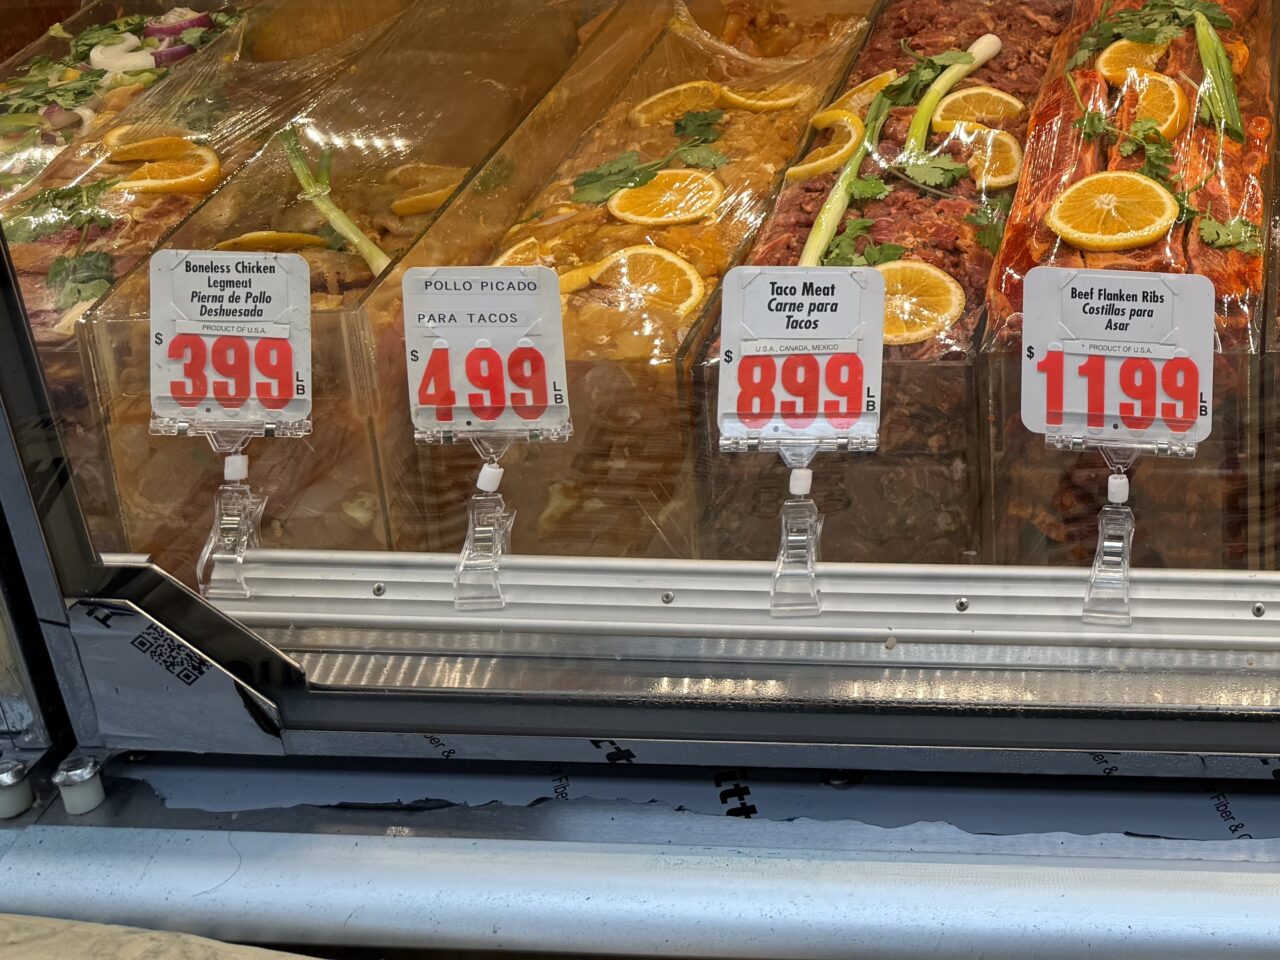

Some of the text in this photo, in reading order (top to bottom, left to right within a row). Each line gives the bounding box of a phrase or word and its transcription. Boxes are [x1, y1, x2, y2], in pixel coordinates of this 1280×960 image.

[185, 260, 276, 274] Boneless Chicken
[208, 277, 252, 291] Legmeat
[425, 281, 537, 291] POLLO PICADO
[770, 282, 836, 296] Taco Meat
[191, 291, 272, 304] Pierna de Pollo
[1071, 287, 1165, 304] Beef Flanken Ribs
[200, 305, 263, 318] Deshuesada
[767, 298, 838, 316] Carne para
[1082, 303, 1154, 320] Costillas para
[418, 313, 518, 323] PARA TACOS
[785, 315, 819, 329] Tacos
[1105, 319, 1130, 332] Asar
[1089, 344, 1121, 352] PRODUCT
[1209, 793, 1236, 824] Fiber
